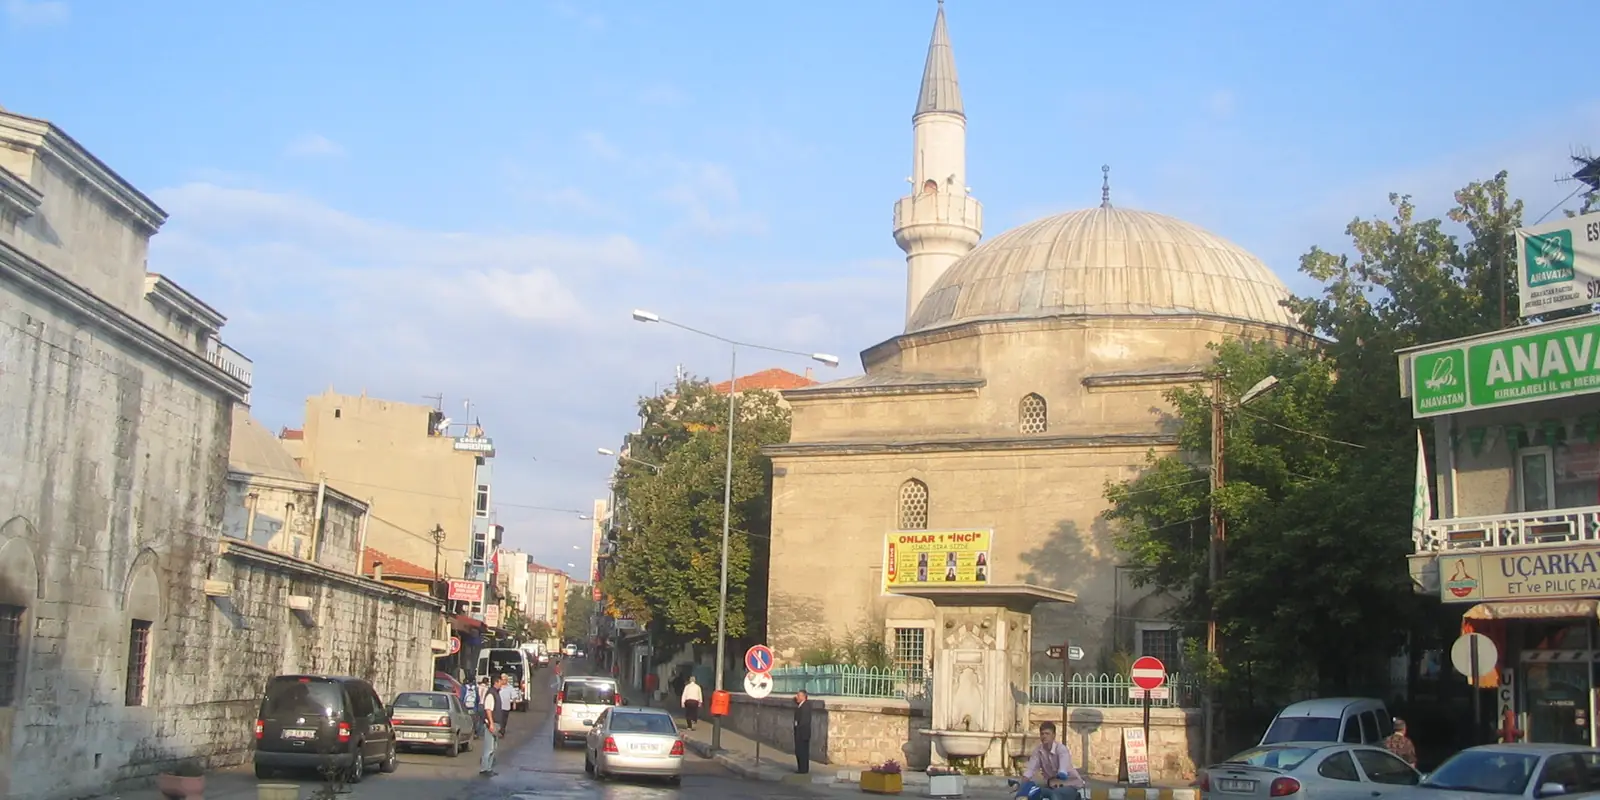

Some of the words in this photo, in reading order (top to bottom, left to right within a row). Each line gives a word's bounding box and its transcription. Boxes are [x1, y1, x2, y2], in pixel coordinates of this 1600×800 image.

[1586, 221, 1600, 241] ES
[1530, 268, 1573, 284] ANAVATAN
[1486, 333, 1600, 386] ANAV
[1494, 382, 1547, 399] KIRKLARELİ
[1420, 392, 1464, 409] ANAVATAN
[899, 534, 936, 544] ONLAR
[938, 534, 944, 542] 1
[1500, 551, 1600, 581] UÇARKA
[1508, 582, 1523, 594] ET
[1526, 584, 1541, 593] ve
